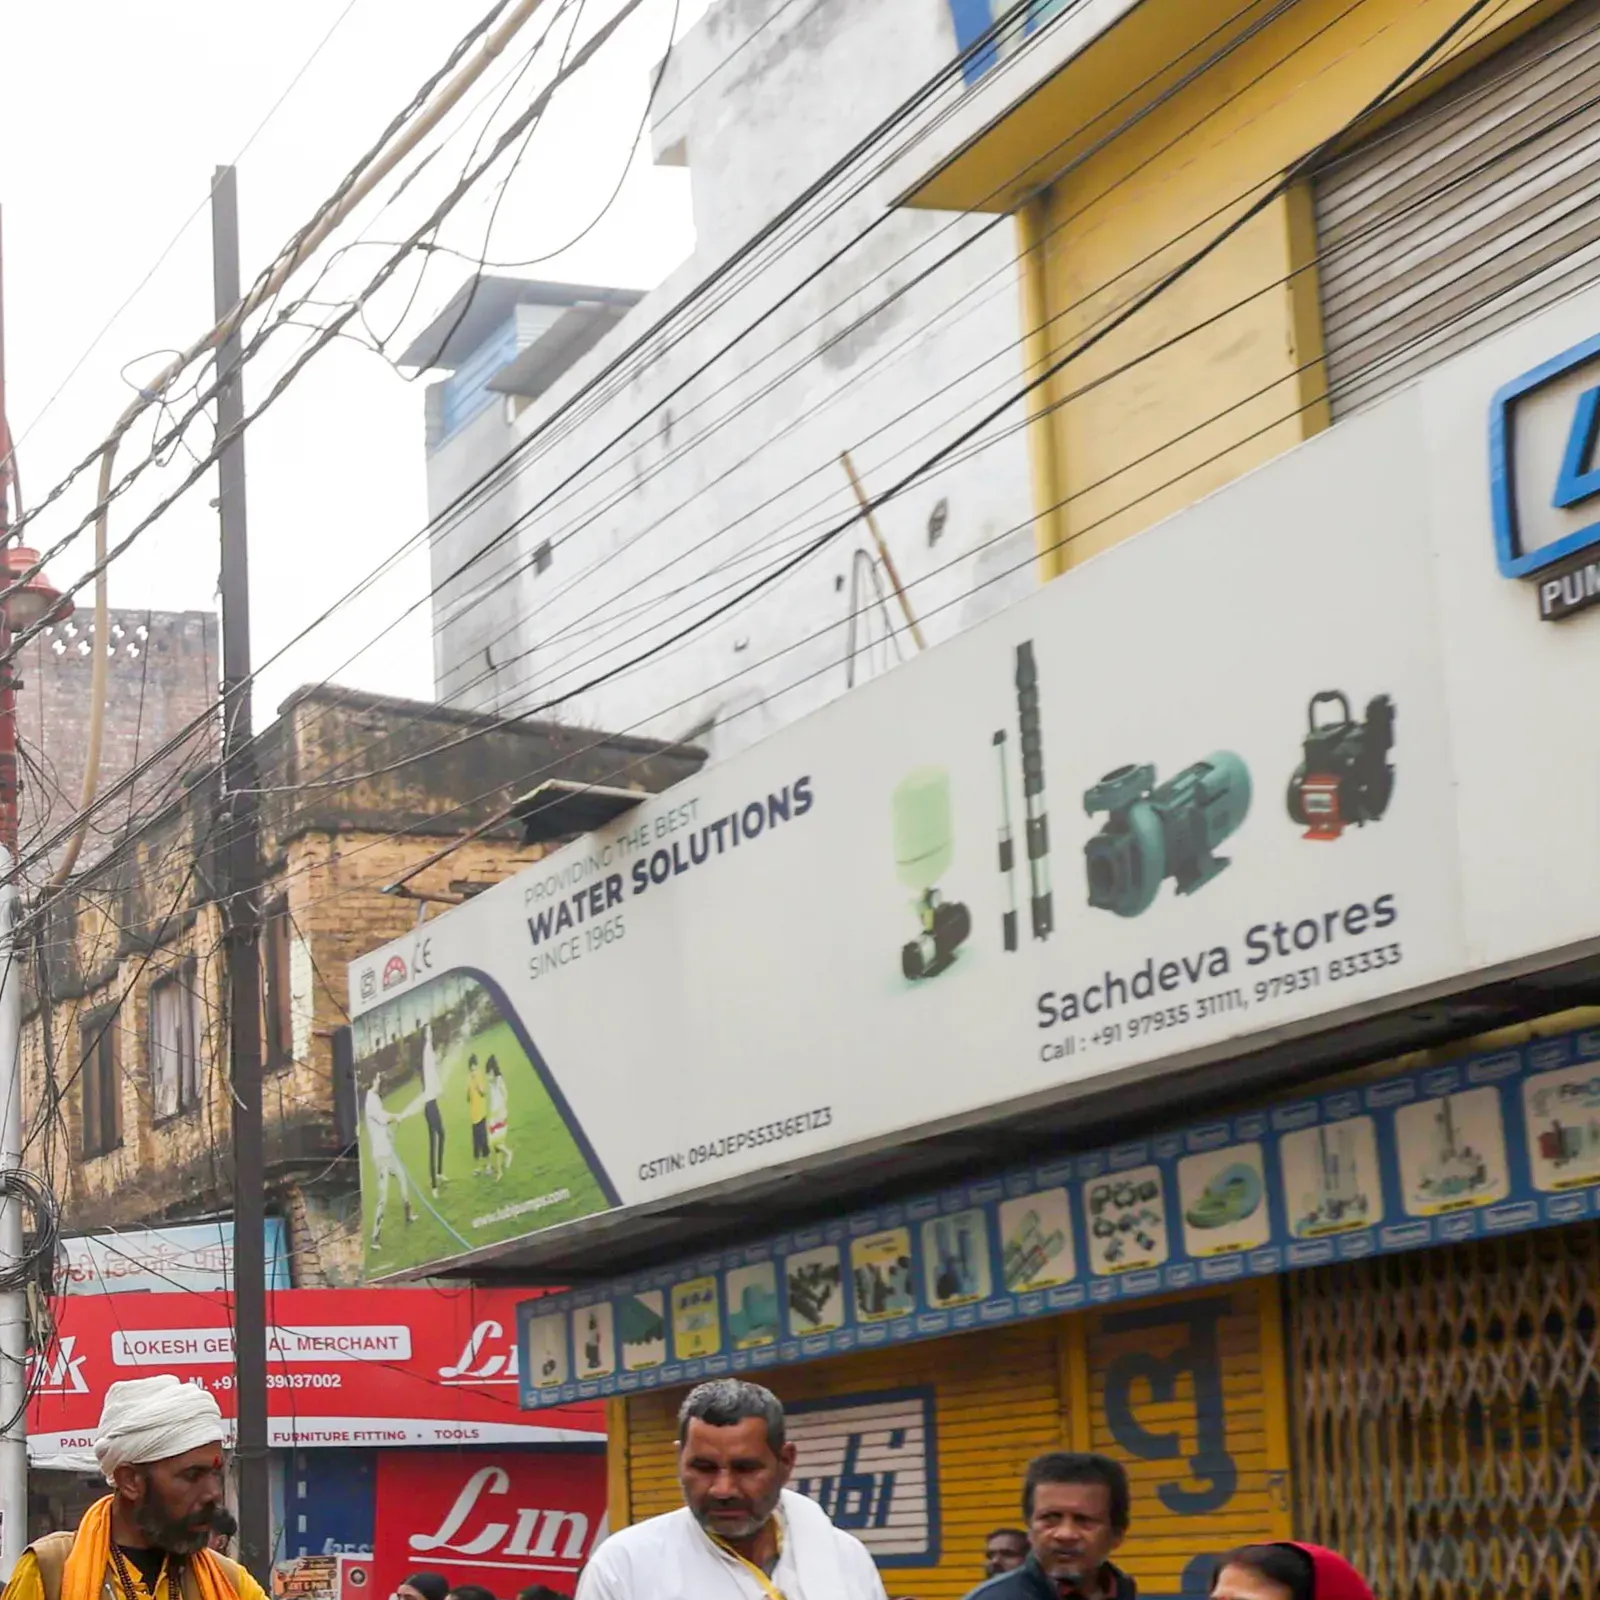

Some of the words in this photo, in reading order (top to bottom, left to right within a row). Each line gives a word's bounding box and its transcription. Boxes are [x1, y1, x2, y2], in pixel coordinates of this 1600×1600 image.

[524, 844, 613, 908] PROVIDING
[615, 823, 649, 859] THE
[655, 798, 701, 839] BEST
[527, 873, 624, 947] WATER
[632, 776, 814, 895] SOLUTIONS
[530, 936, 581, 980] SINCE
[585, 915, 626, 953] 1965
[1037, 946, 1229, 1028] Sachdeva
[1245, 894, 1398, 966] Stores
[1040, 1037, 1076, 1063] Call
[1091, 1023, 1122, 1046] +91
[1127, 1003, 1190, 1038] 97935
[1254, 966, 1320, 1002] 97931
[1328, 943, 1402, 982] 83333
[638, 1154, 685, 1181] GSTIN:
[123, 1339, 198, 1356] LOKESH
[204, 1335, 291, 1354] GEAL
[297, 1335, 400, 1351] MERCHANT
[60, 1437, 97, 1449] PADL
[273, 1430, 350, 1442] FURNITURE
[354, 1430, 407, 1441] FITTING
[434, 1428, 480, 1440] TOOLS
